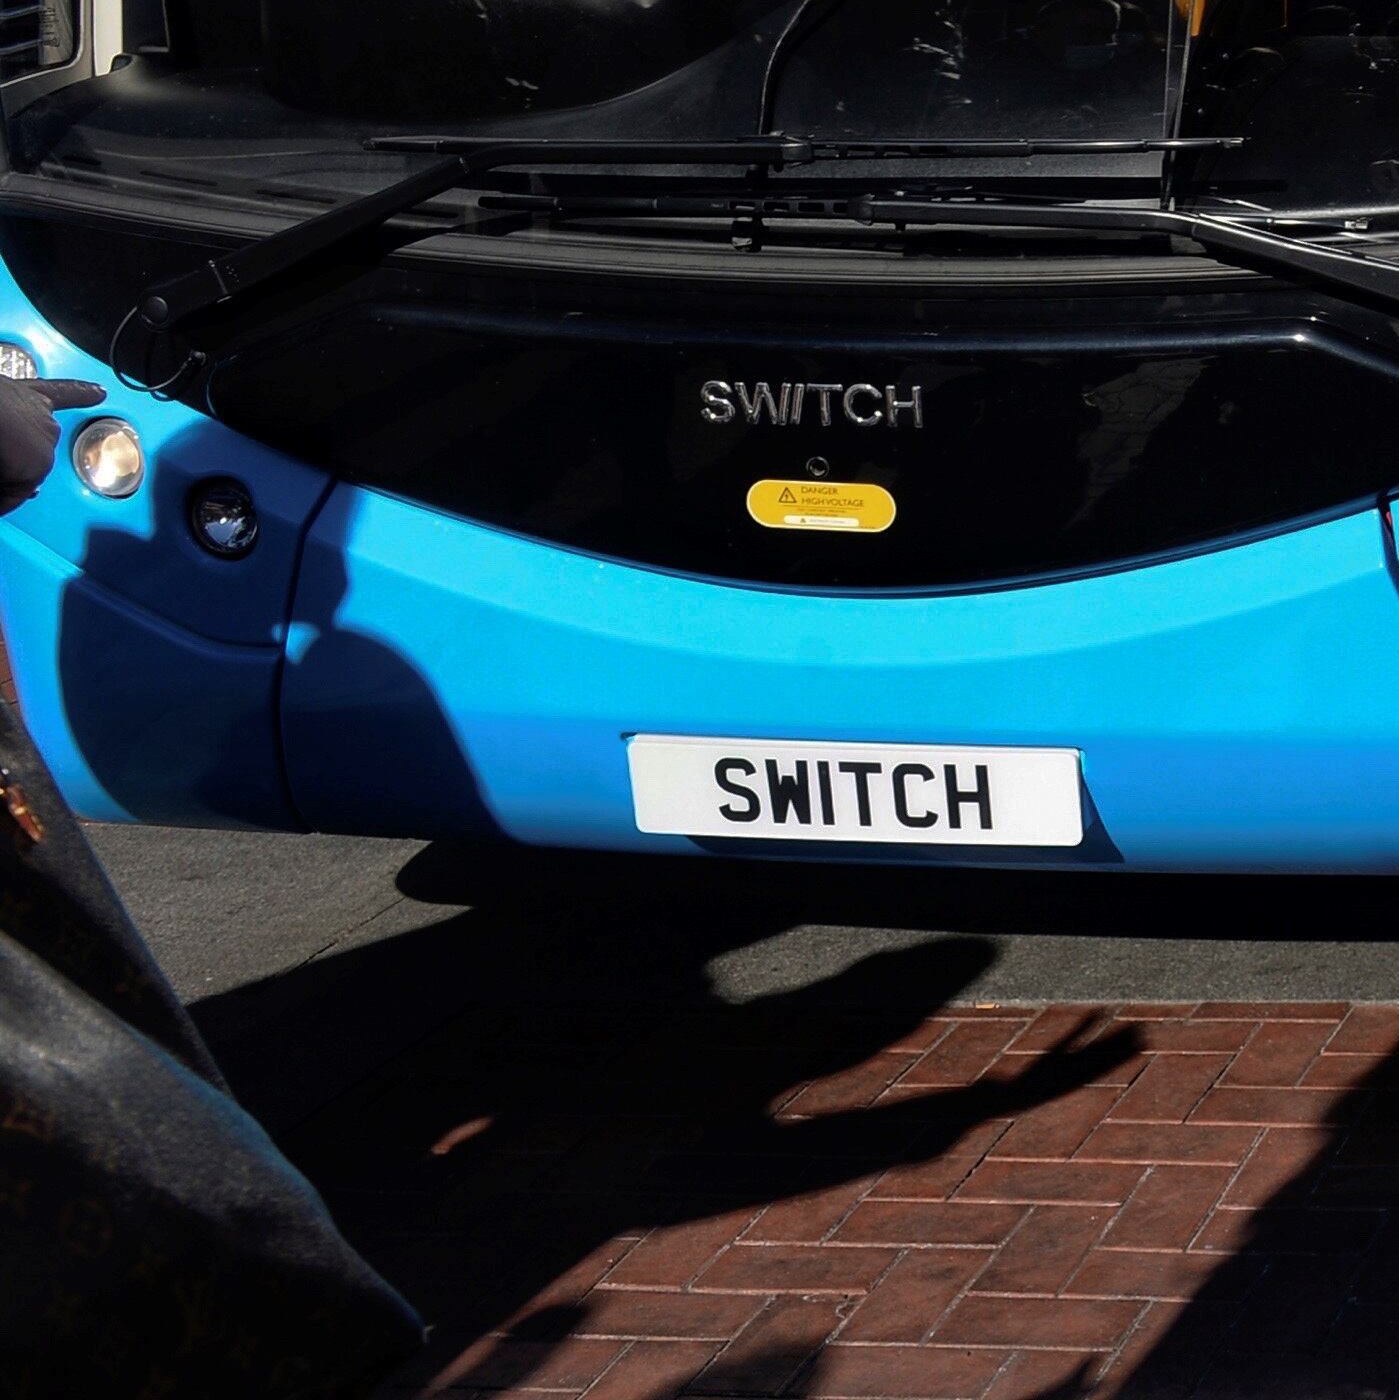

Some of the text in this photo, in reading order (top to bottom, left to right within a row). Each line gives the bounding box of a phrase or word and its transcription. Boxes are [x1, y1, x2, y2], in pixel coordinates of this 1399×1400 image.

[701, 380, 923, 428] SWITCH
[801, 486, 838, 495] DANGER
[801, 497, 864, 507] HIGH VOLTAGE
[714, 757, 993, 830] SWITCH
